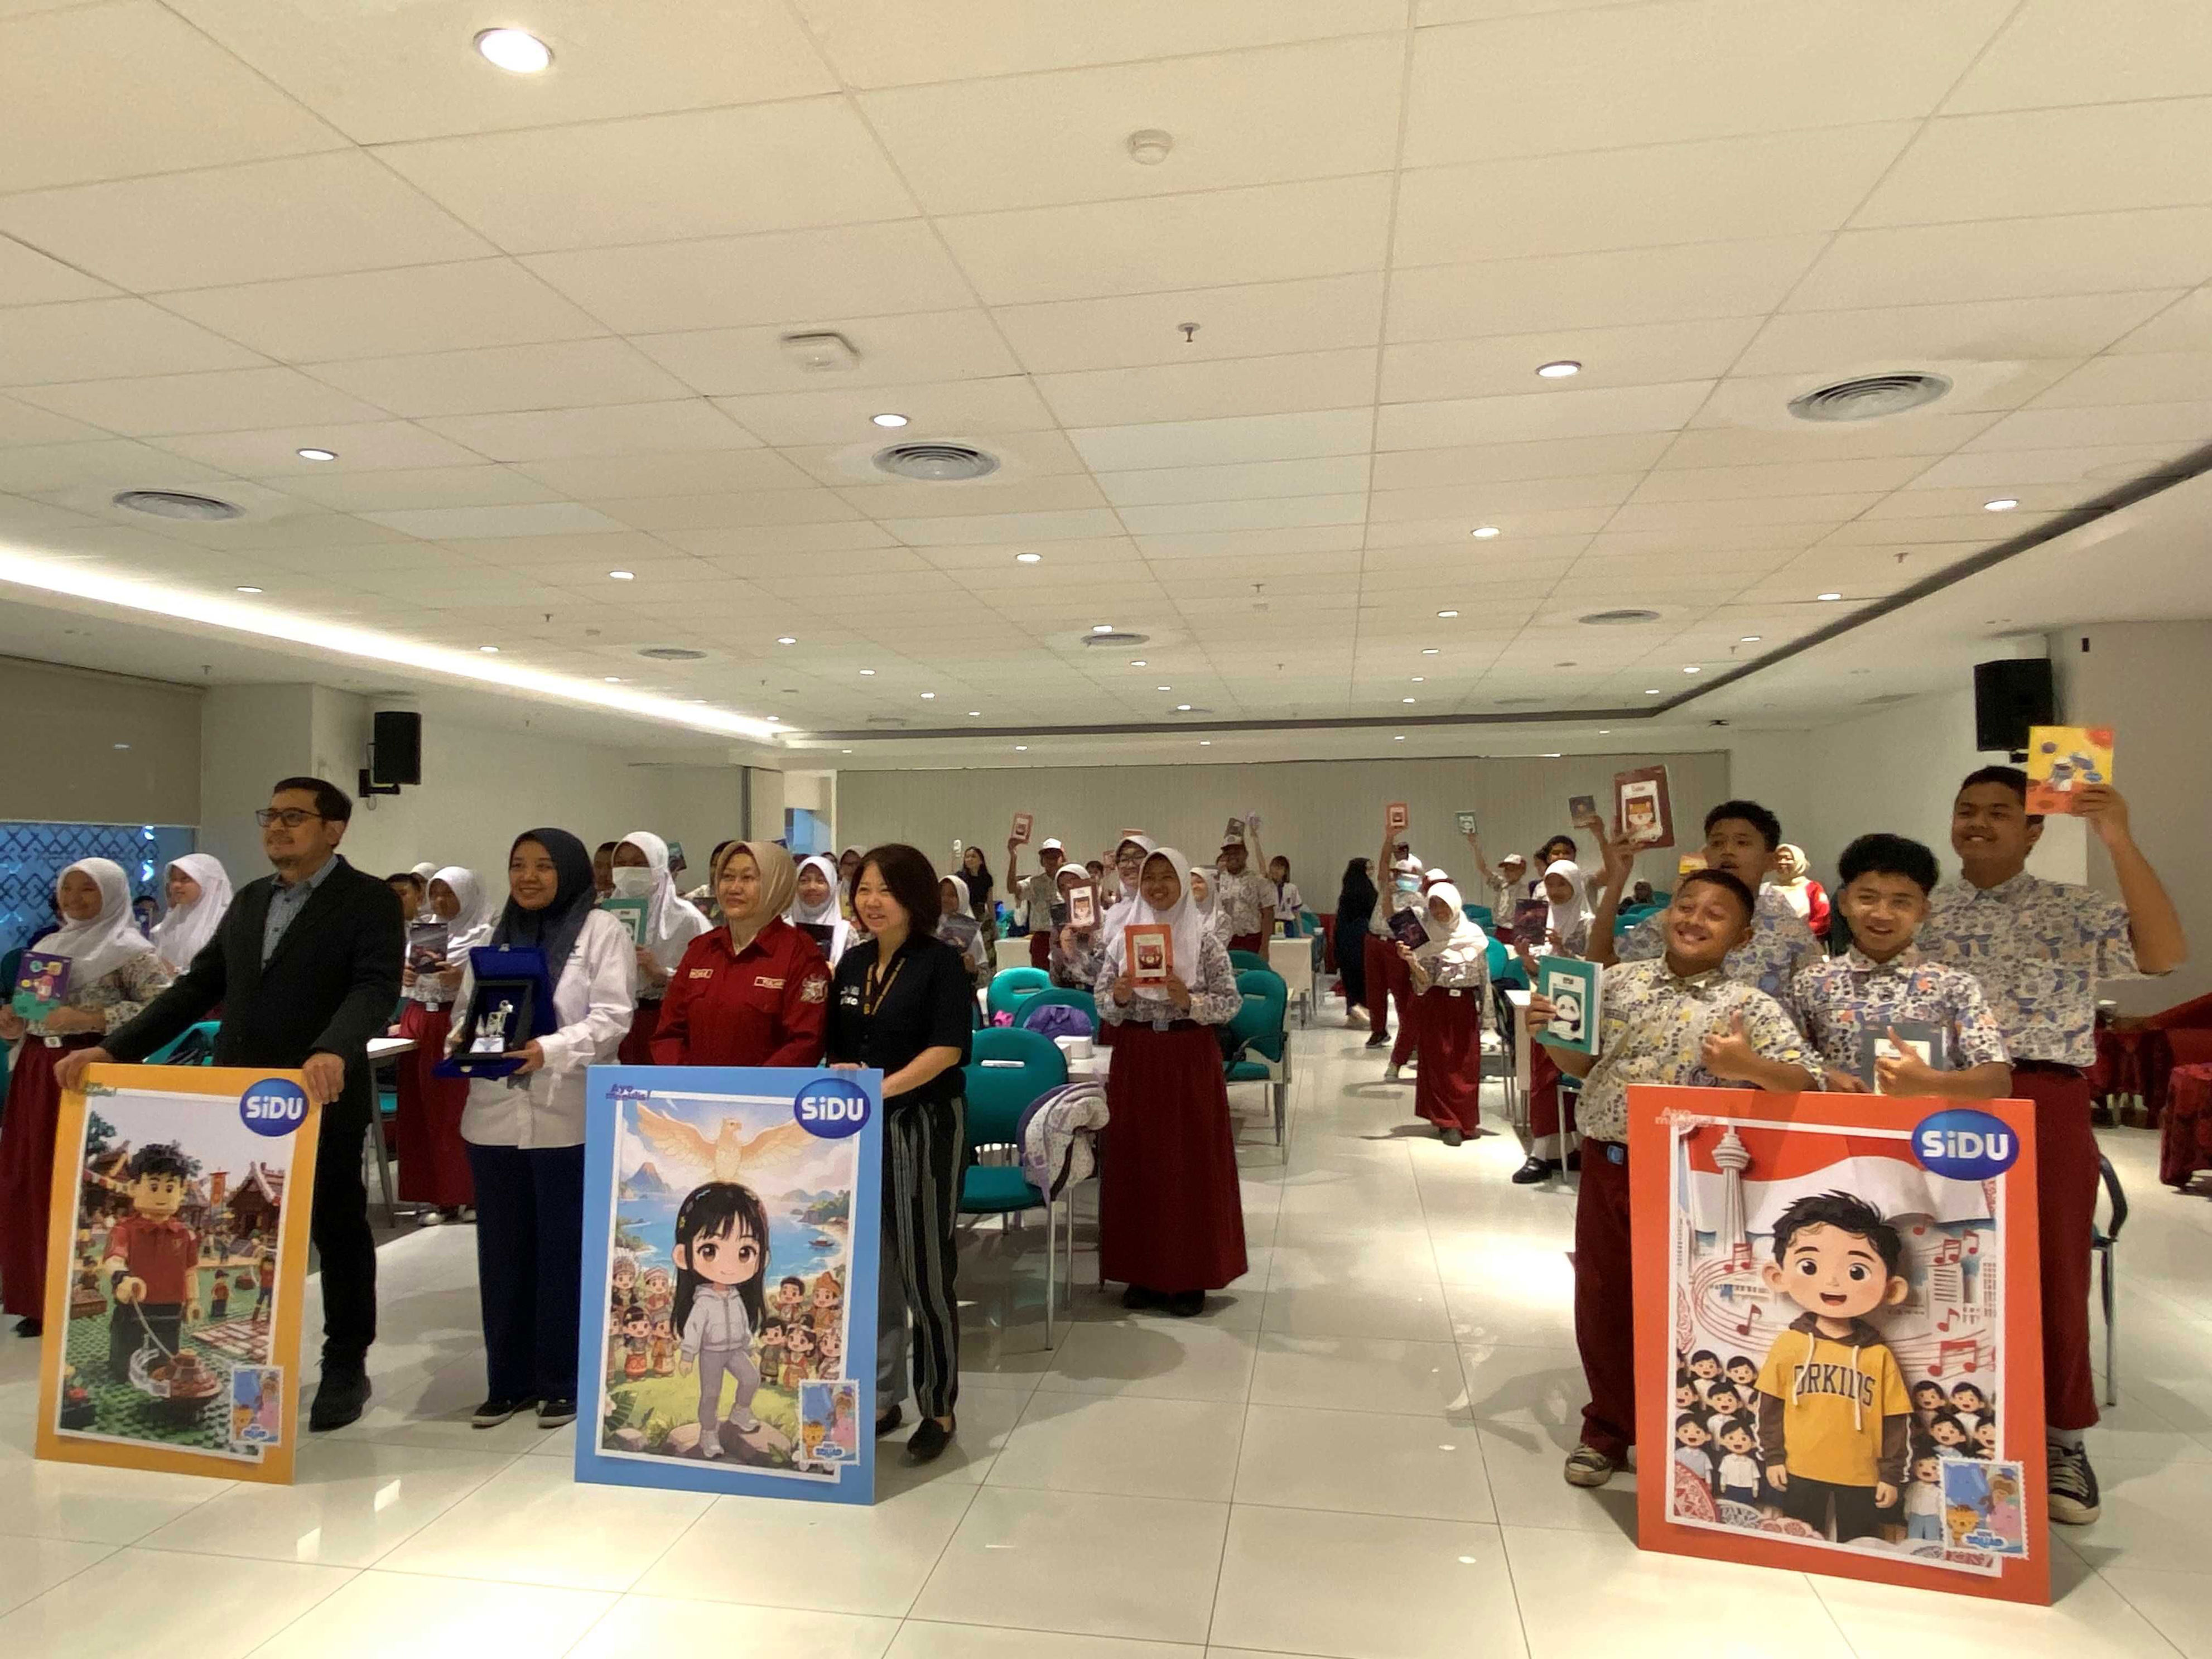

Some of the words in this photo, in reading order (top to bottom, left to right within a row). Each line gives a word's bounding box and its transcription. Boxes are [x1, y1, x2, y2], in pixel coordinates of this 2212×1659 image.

[246, 1096, 303, 1120] SiDU
[802, 1096, 864, 1121] SiDU
[1922, 1130, 2008, 1161] SiDU
